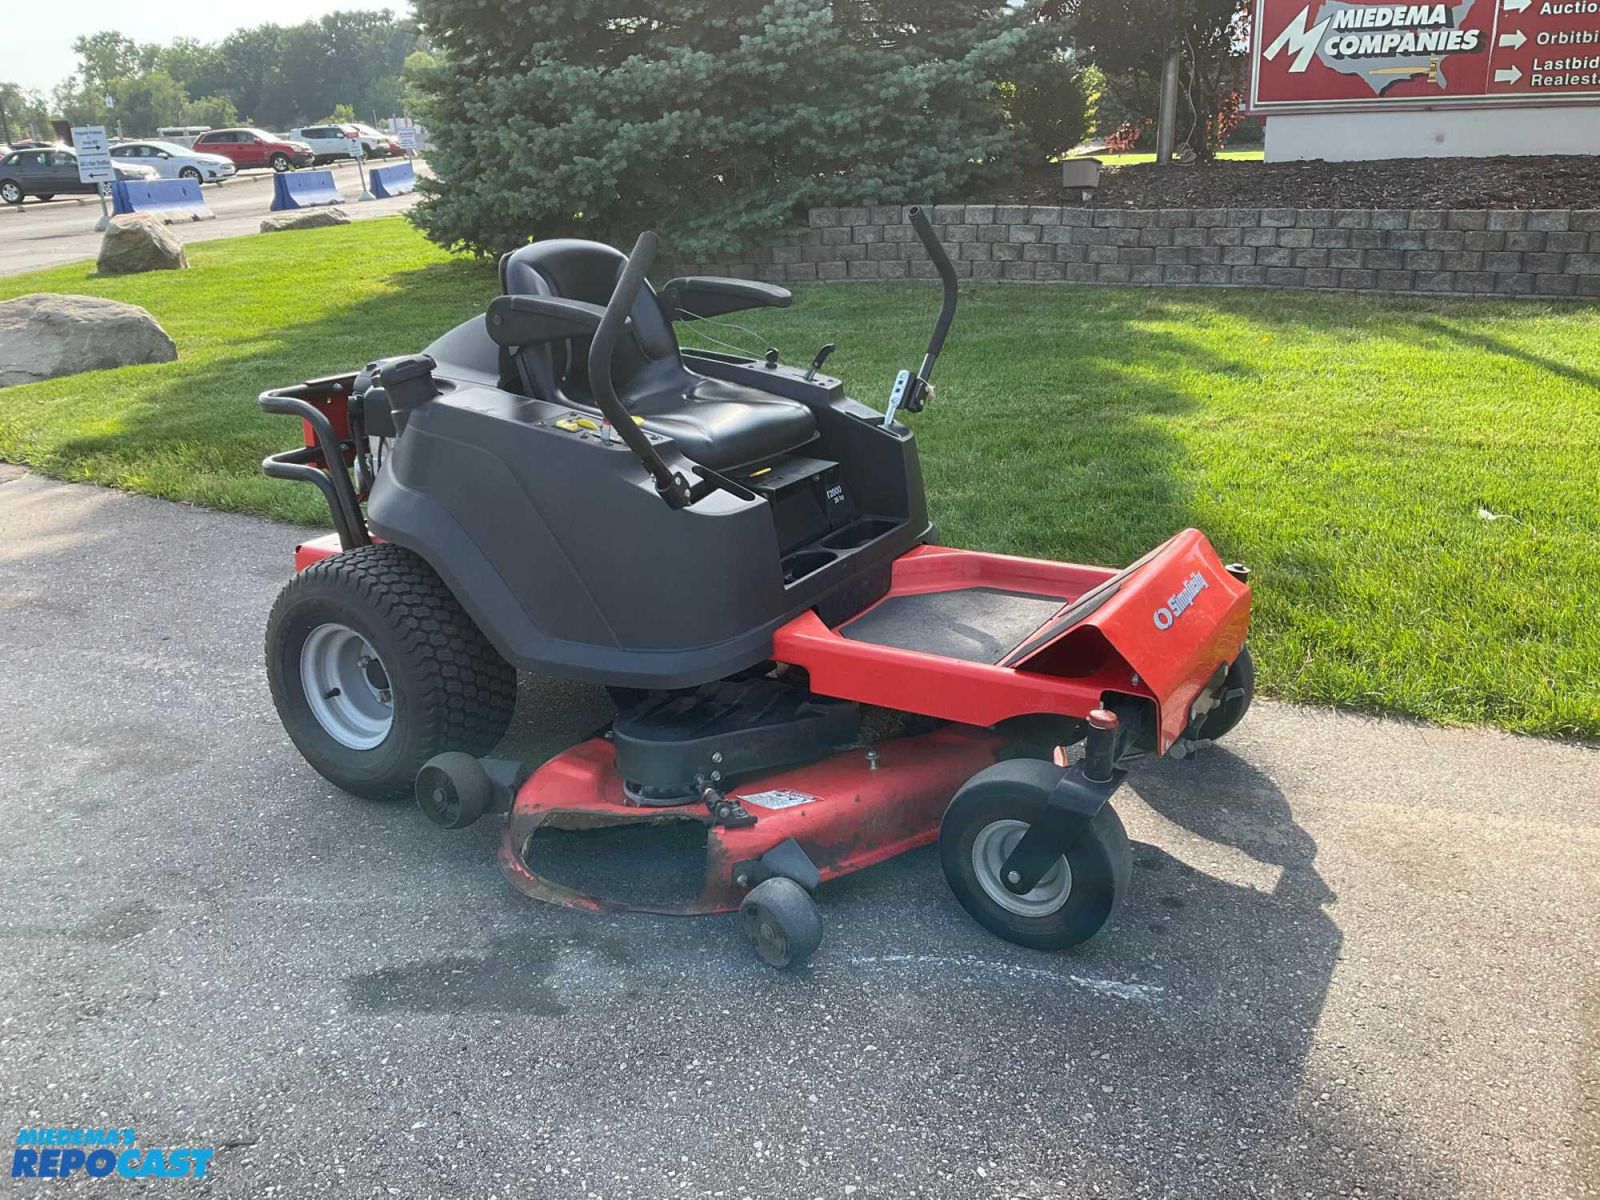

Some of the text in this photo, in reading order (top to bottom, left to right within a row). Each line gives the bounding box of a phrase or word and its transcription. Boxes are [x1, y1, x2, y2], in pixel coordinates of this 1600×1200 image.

[1333, 4, 1447, 29] MIEDEMA
[1540, 1, 1600, 15] Auctio
[1324, 29, 1480, 56] COMPANIES
[1533, 56, 1600, 71] Lastbid
[1531, 73, 1600, 86] Realest
[1167, 571, 1209, 617] Simplicity
